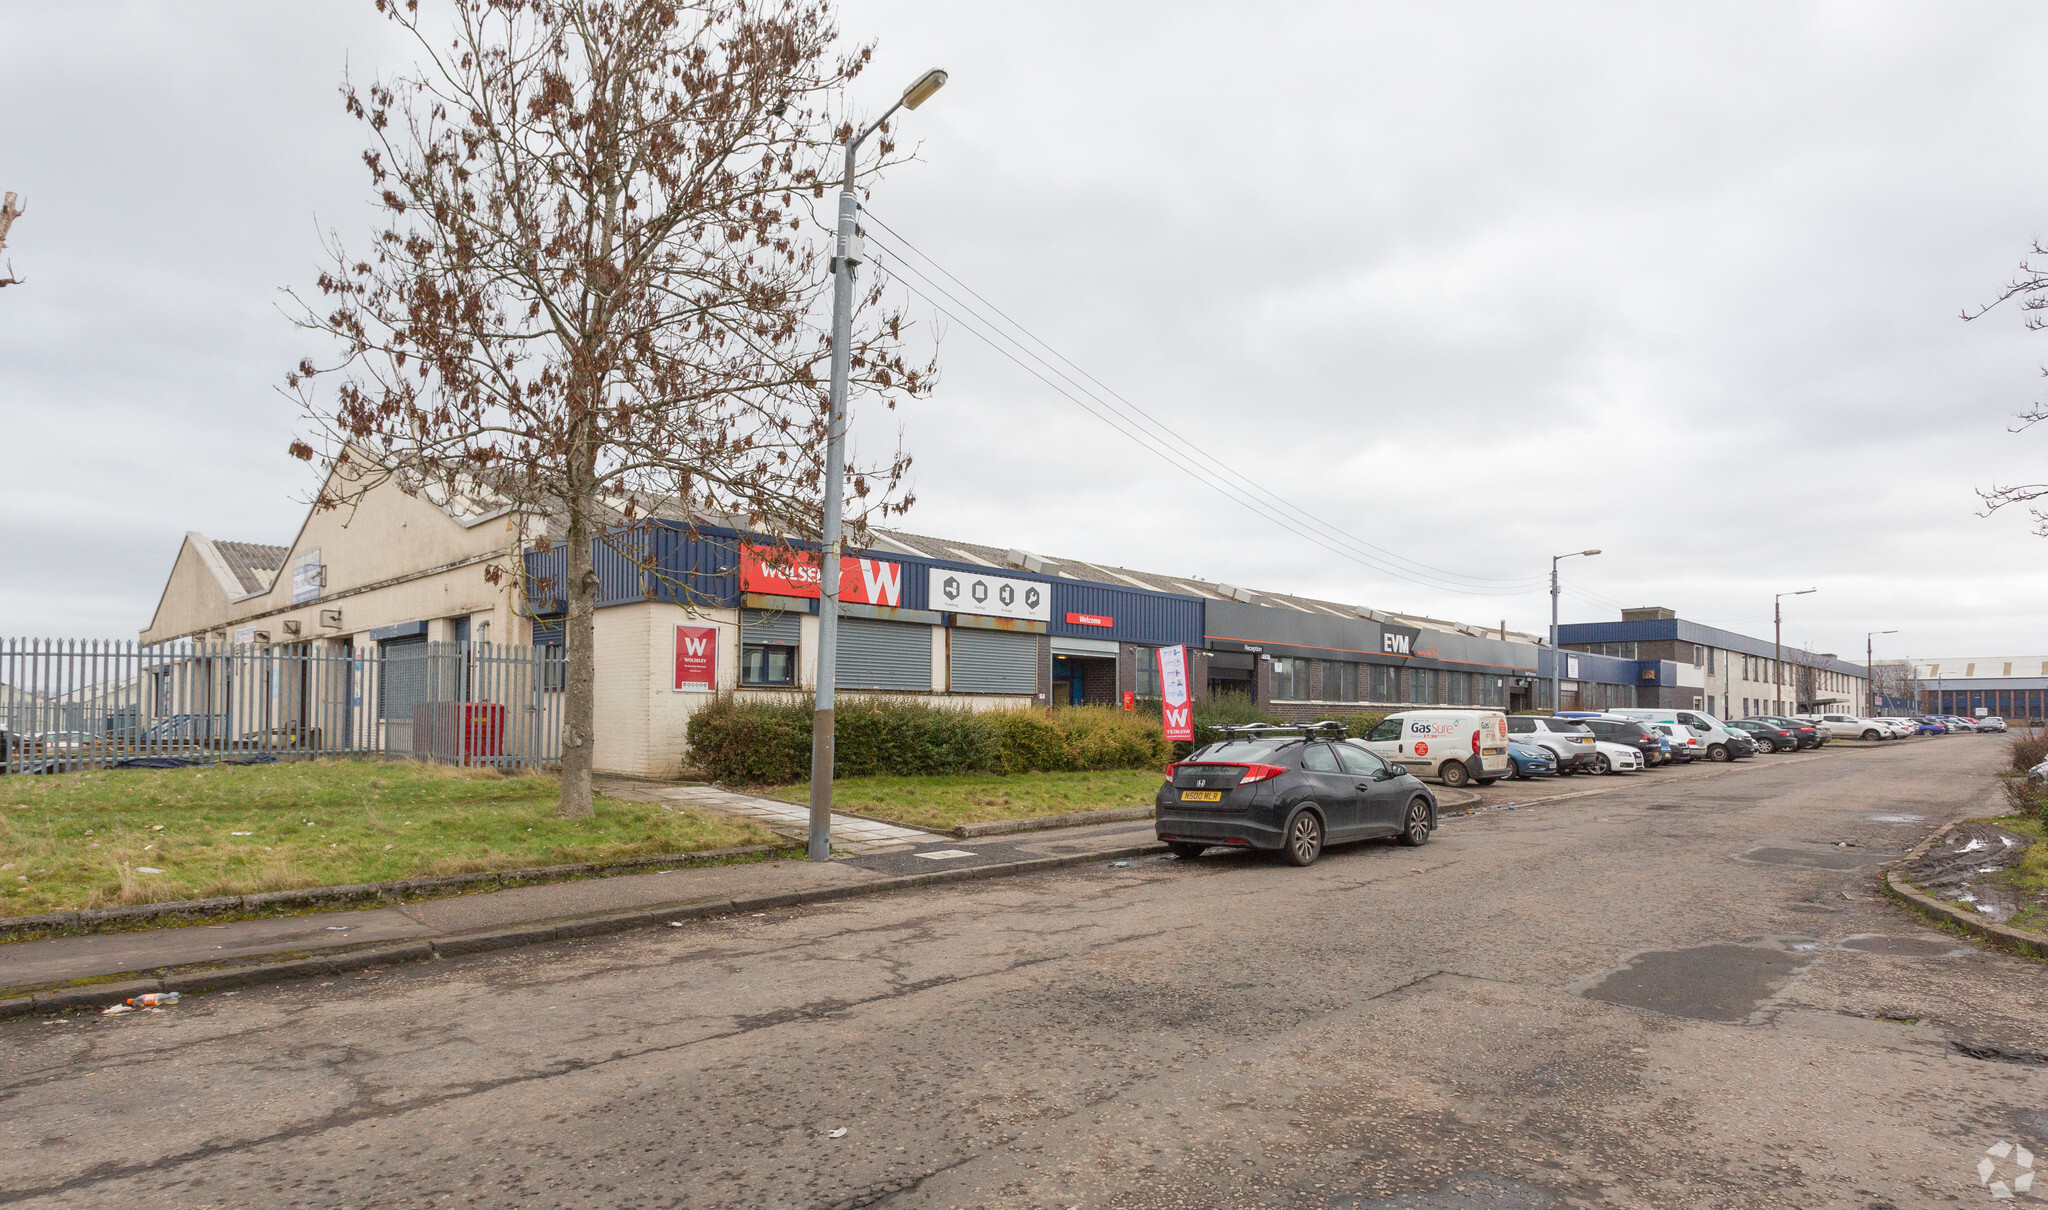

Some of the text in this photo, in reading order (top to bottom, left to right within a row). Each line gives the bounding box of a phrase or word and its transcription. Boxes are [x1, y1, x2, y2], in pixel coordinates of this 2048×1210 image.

[761, 561, 843, 584] WOLSEL
[859, 558, 900, 606] W
[1079, 615, 1101, 624] Welcome
[685, 637, 707, 656] W
[1384, 633, 1409, 654] EVM
[1184, 791, 1218, 800] N500 MLR
